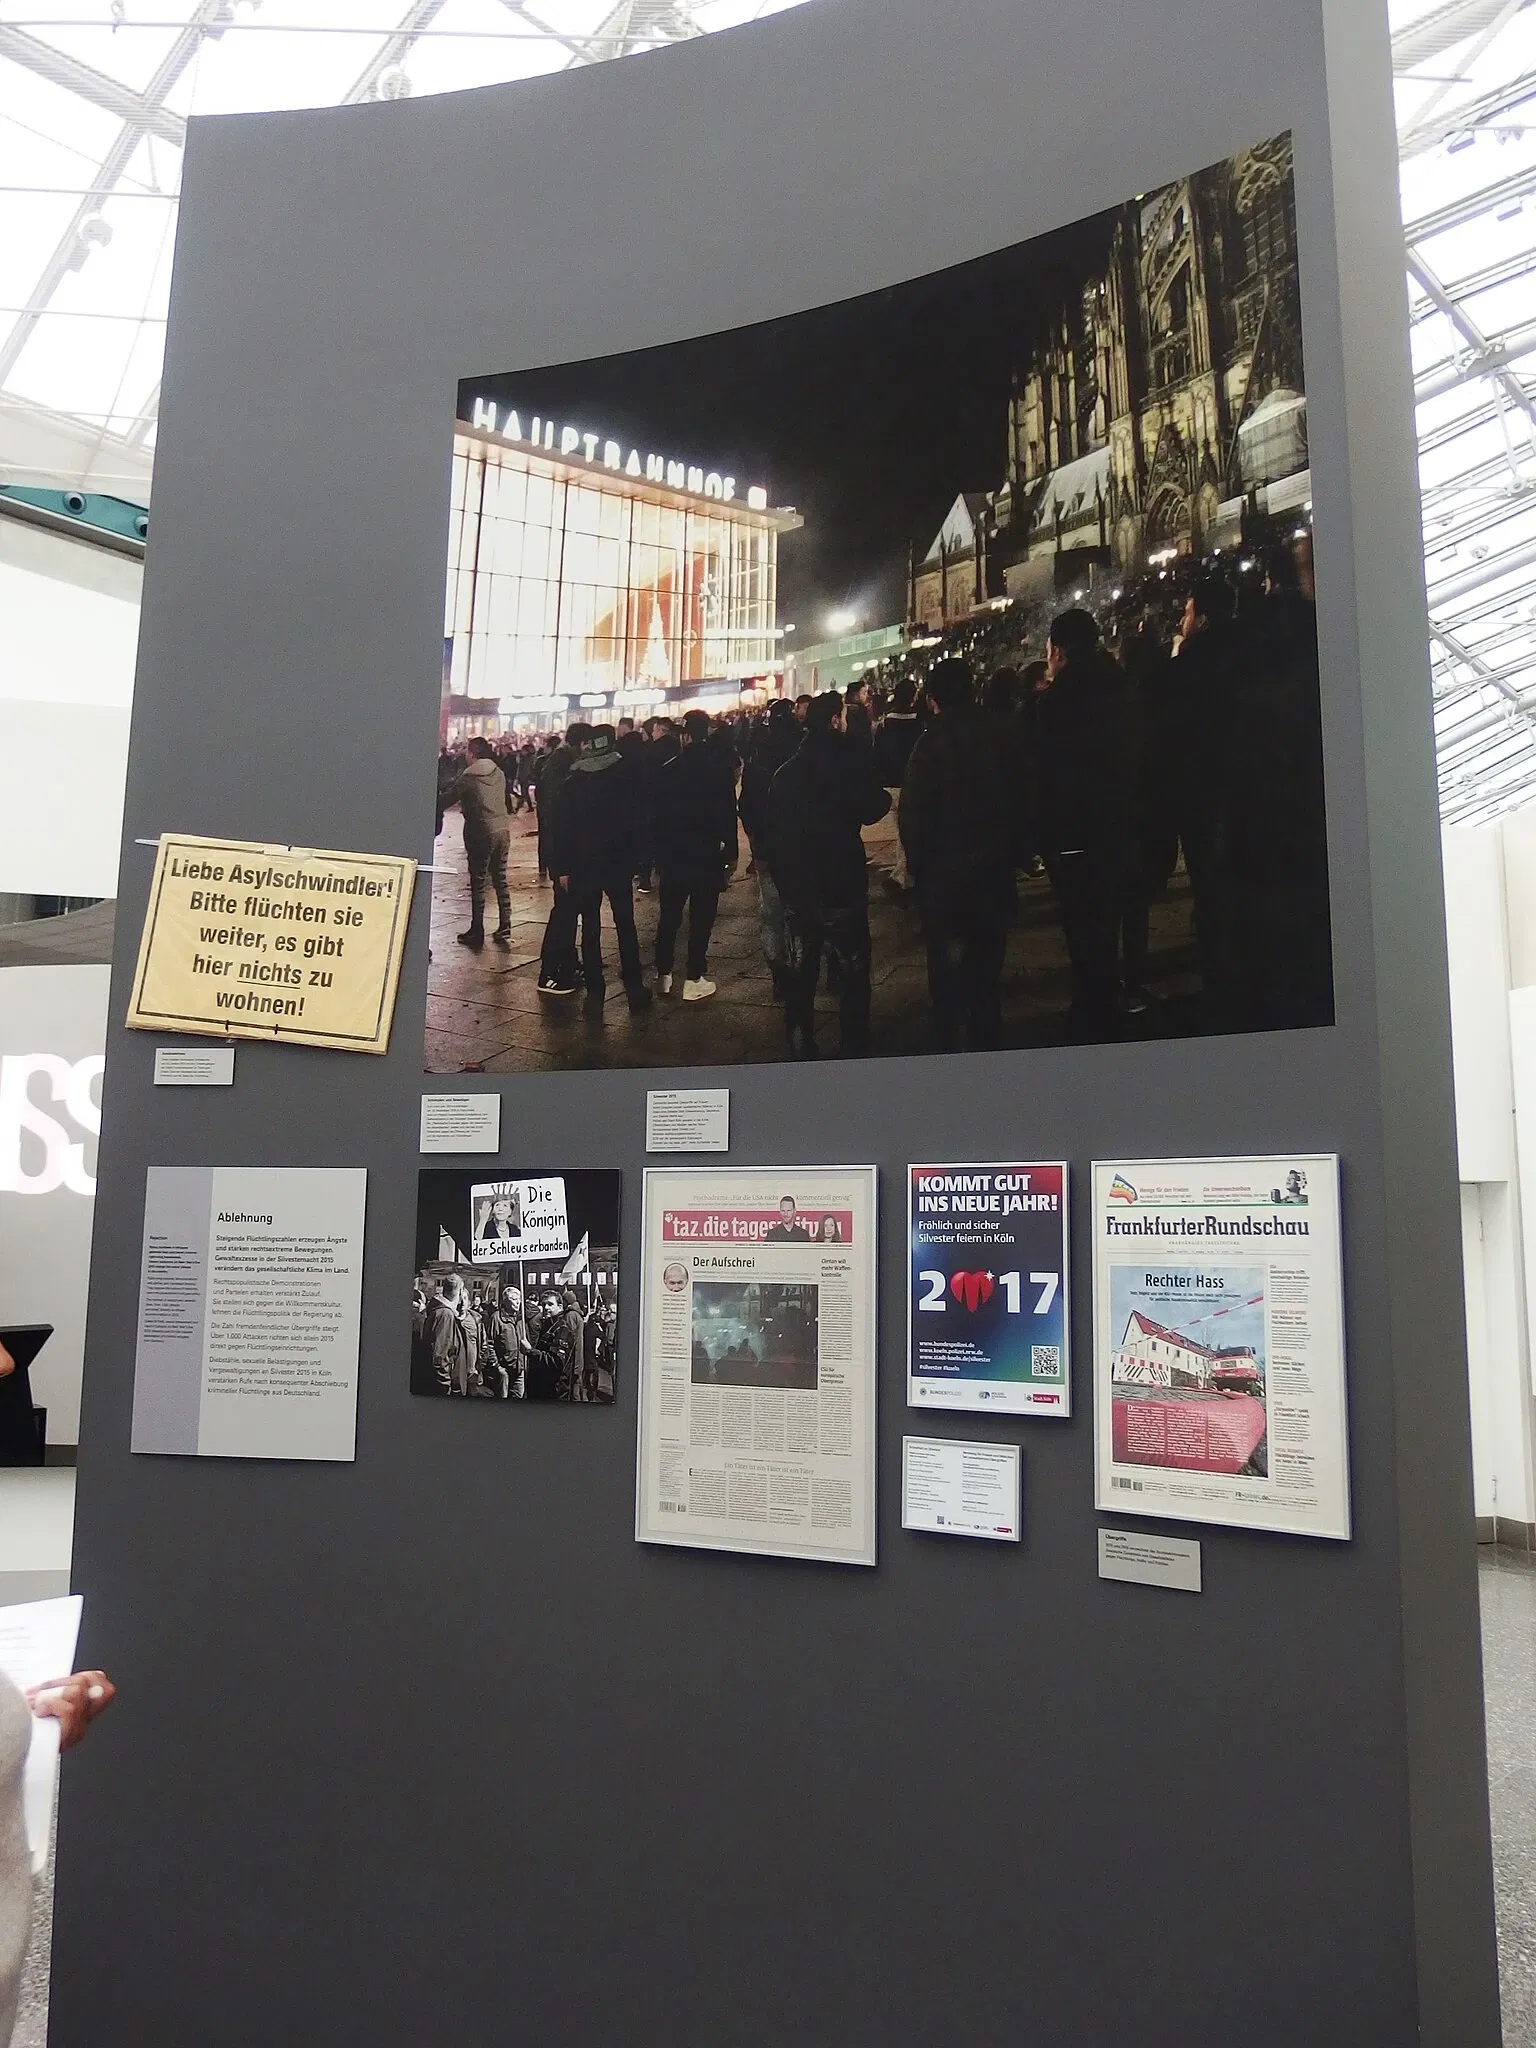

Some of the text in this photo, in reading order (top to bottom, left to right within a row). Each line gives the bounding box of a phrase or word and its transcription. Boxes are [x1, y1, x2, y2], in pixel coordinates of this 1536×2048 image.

[171, 858, 394, 898] Liebe Asylschwindler!
[190, 891, 364, 927] Bitte flüchten sie
[200, 926, 344, 957] weiter, es gibt
[192, 954, 333, 988] hier nichts zu
[216, 991, 305, 1016] wohnen!
[919, 1175, 1031, 1192] KOMMT GUT
[528, 1186, 552, 1203] Die
[919, 1195, 1057, 1215] INS NEUE JAHR!
[218, 1212, 273, 1225] Ablehnung
[522, 1209, 565, 1230] Königin
[919, 1221, 1000, 1230] Fröhlich und sicher
[919, 1233, 1014, 1242] Silvester feiern in Köln
[473, 1244, 487, 1257] der
[693, 1257, 709, 1267] Der
[711, 1257, 755, 1268] Aufschrei
[1145, 1273, 1224, 1288] Rechter Hass
